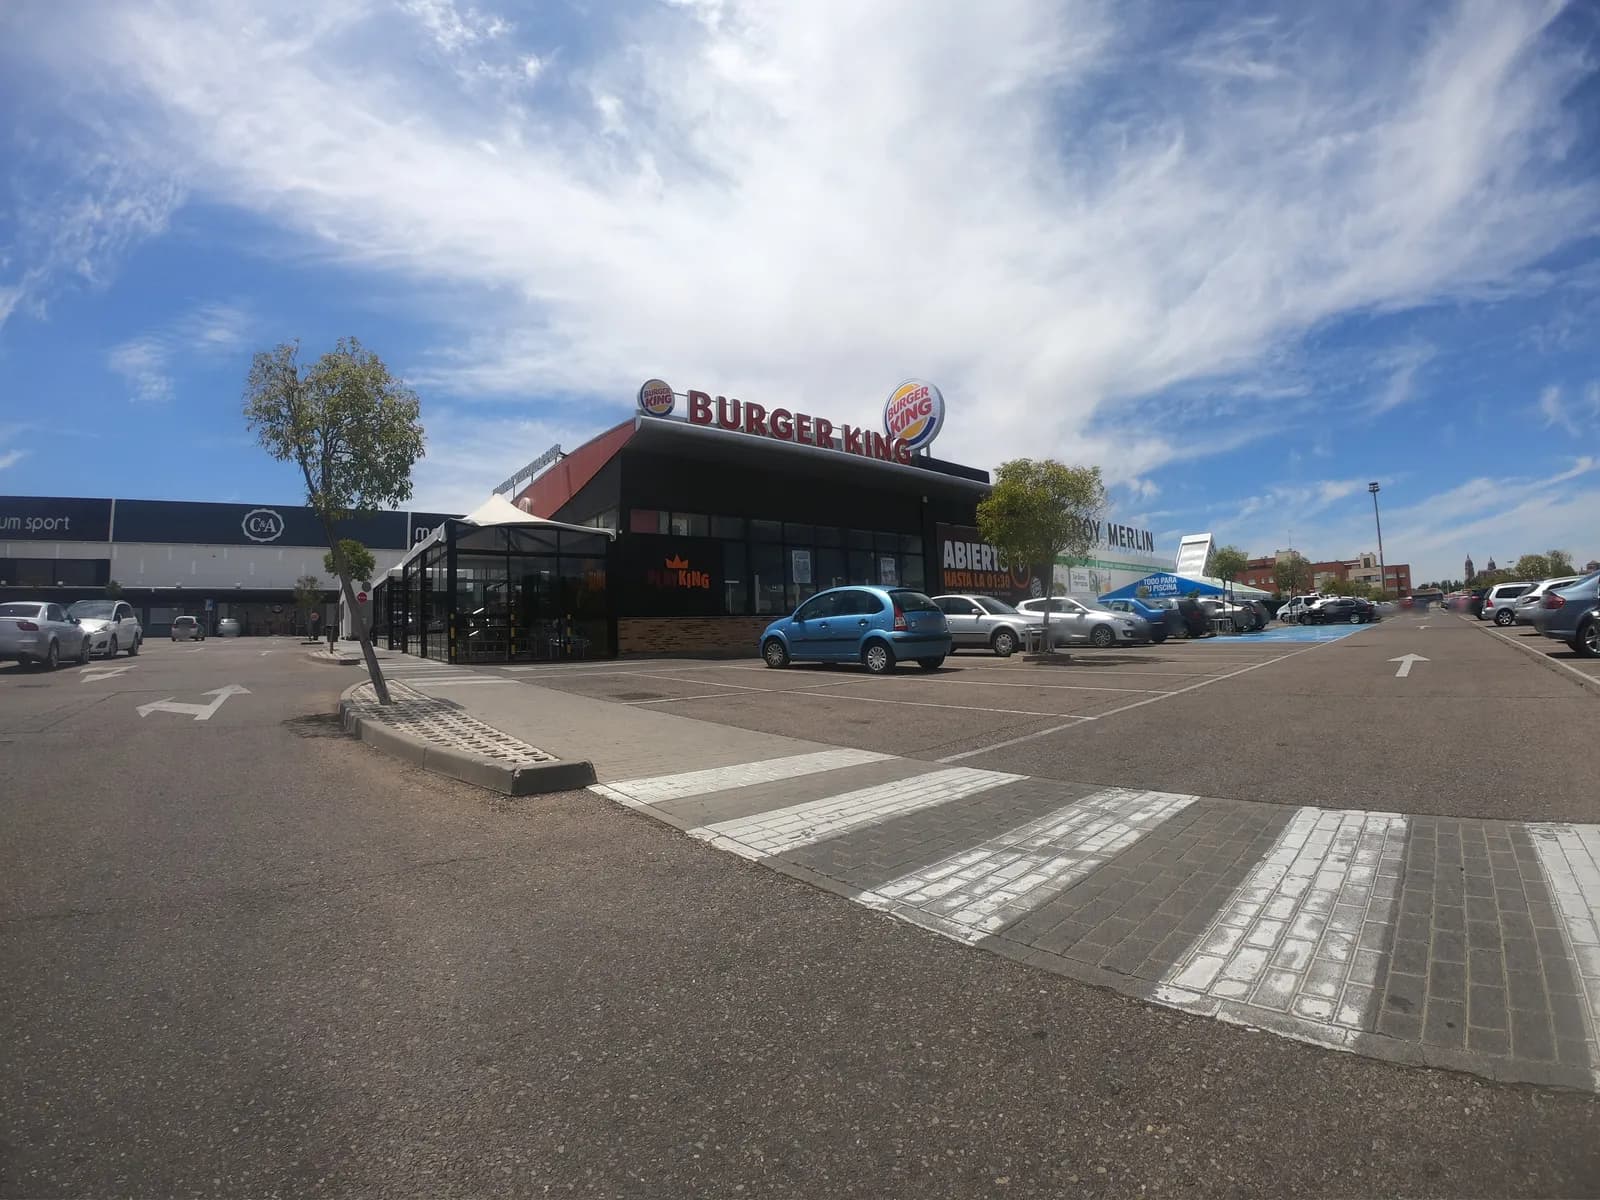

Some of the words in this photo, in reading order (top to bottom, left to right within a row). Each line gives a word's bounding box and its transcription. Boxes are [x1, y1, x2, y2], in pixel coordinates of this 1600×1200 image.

[644, 387, 671, 399] BURGER
[645, 394, 672, 408] KING
[888, 386, 929, 420] BURGER
[890, 397, 932, 438] KING
[686, 389, 833, 450] BURGER
[841, 423, 912, 465] KING
[25, 516, 71, 533] sport
[250, 517, 277, 533] C&A
[1108, 522, 1154, 552] MERLIN
[944, 570, 973, 588] HASTA
[974, 572, 985, 588] LA
[1144, 577, 1160, 585] TODO
[1161, 576, 1177, 584] PARA
[1153, 583, 1177, 592] PISCINA
